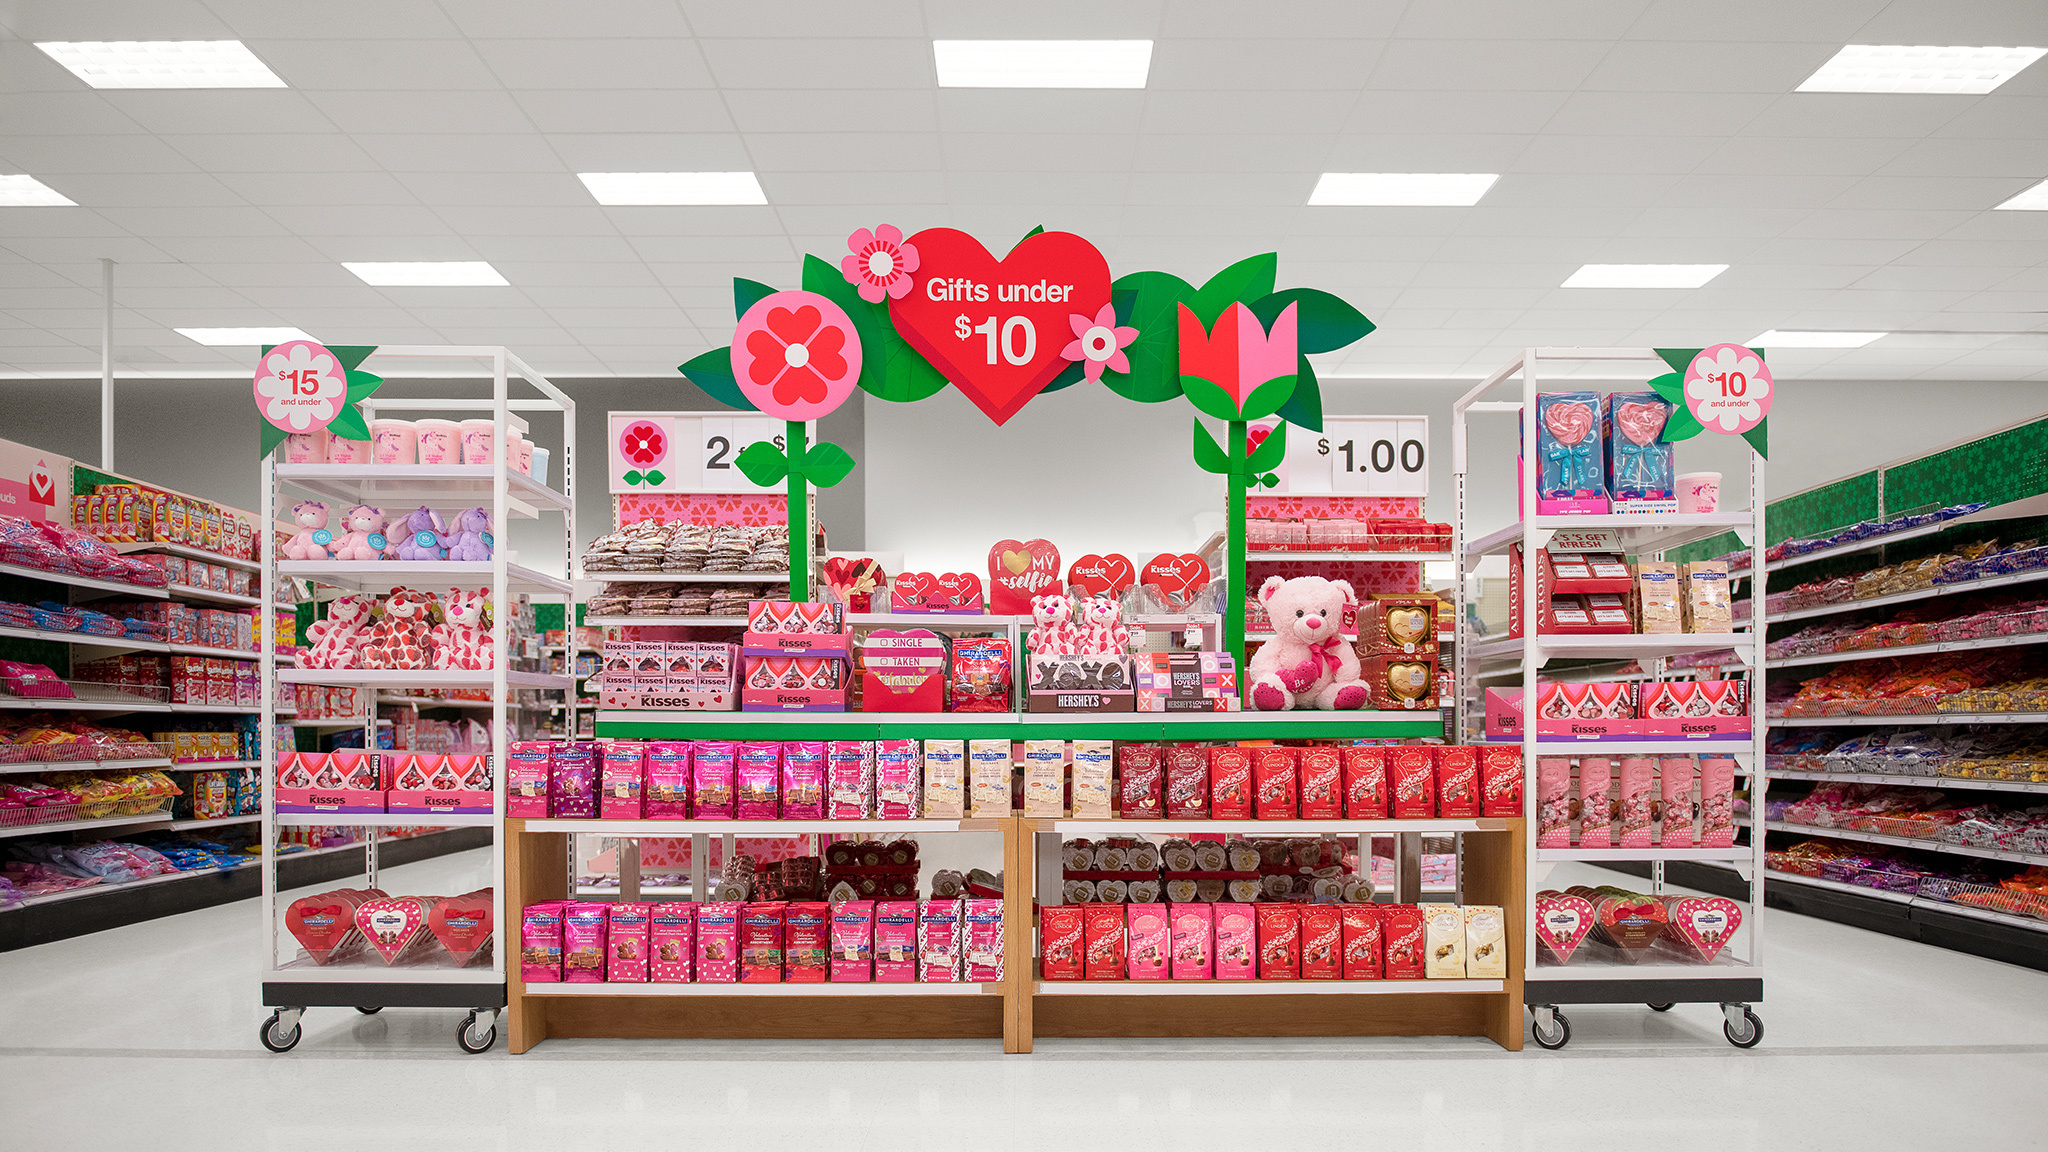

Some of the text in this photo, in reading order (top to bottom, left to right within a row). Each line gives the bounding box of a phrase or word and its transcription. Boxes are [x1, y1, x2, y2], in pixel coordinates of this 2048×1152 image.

[926, 277, 1074, 303] Gifts under
[954, 313, 1037, 366] $10
[278, 369, 320, 396] $15
[1707, 372, 1748, 398] $10
[280, 398, 322, 407] and under
[1710, 399, 1750, 408] and under
[706, 436, 730, 470] 2
[1317, 437, 1426, 473] $1.00
[1585, 533, 1607, 541] GET
[996, 555, 1055, 571] I MY
[1510, 563, 1519, 633] ALTOIDS
[1537, 554, 1545, 628] ALTOIDS
[892, 638, 923, 647] SINGLE
[892, 657, 920, 666] TAKEN
[1058, 695, 1100, 708] HERSHEY'S
